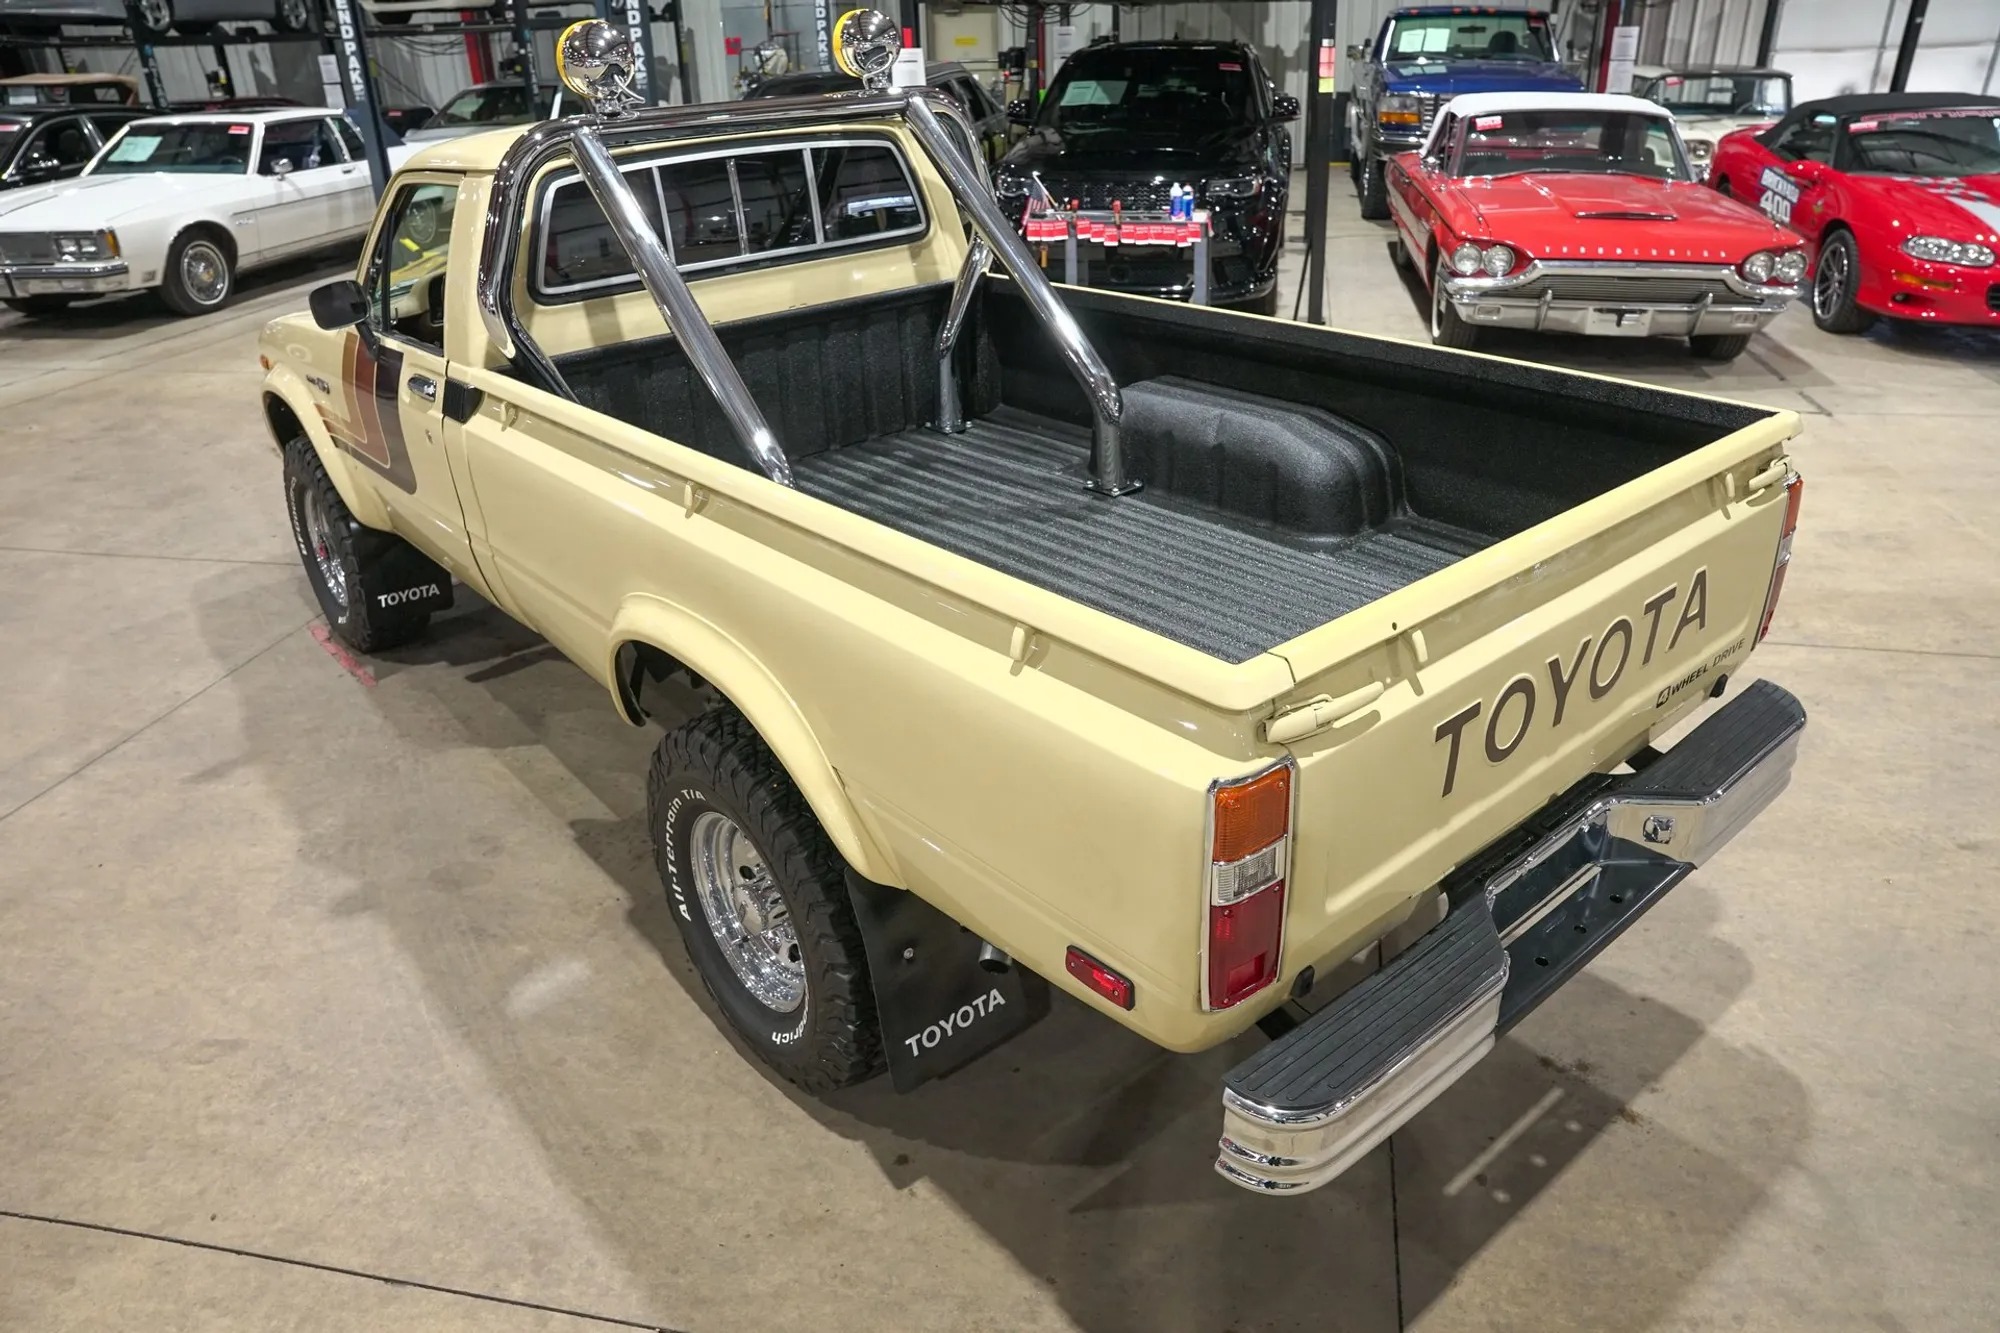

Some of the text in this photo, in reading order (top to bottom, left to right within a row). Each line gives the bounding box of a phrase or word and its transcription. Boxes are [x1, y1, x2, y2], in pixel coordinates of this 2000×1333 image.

[1760, 189, 1791, 224] 400
[377, 583, 440, 608] TOYOTA
[1435, 566, 1707, 797] TOYOTA
[1671, 663, 1708, 695] WHEEL
[1712, 638, 1745, 667] DRIVE
[665, 797, 692, 922] All-Terrain
[904, 988, 1006, 1057] TOYOTA
